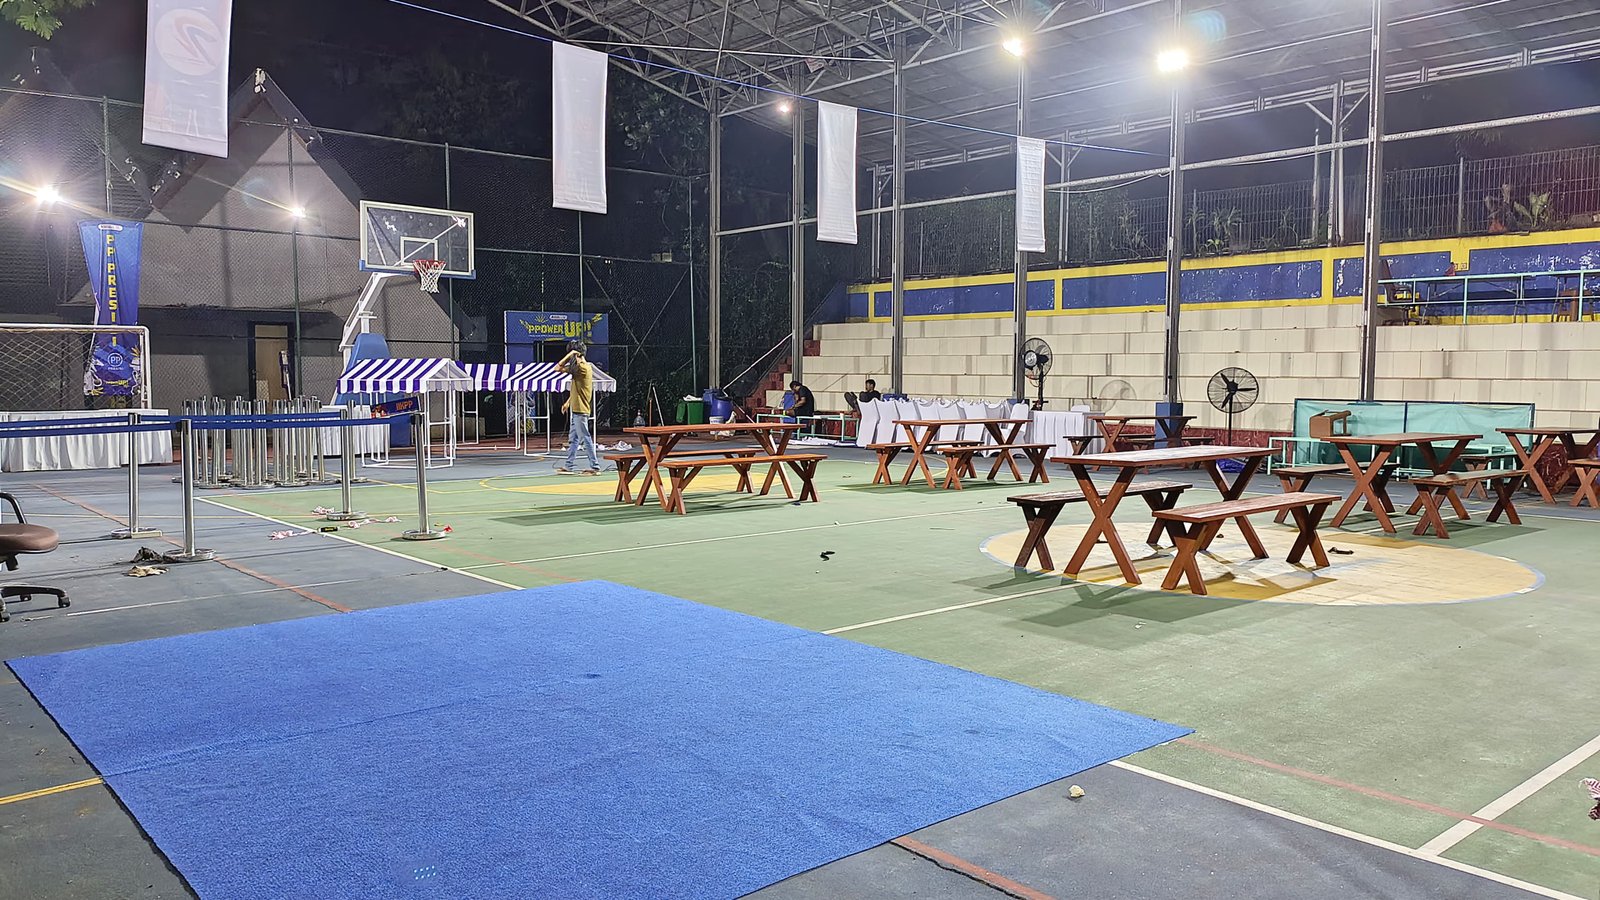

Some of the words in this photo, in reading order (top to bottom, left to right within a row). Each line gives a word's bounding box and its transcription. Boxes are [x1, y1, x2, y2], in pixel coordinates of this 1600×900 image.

[107, 263, 118, 346] PRESII
[528, 324, 563, 334] PPOWER
[564, 320, 592, 337] UP!
